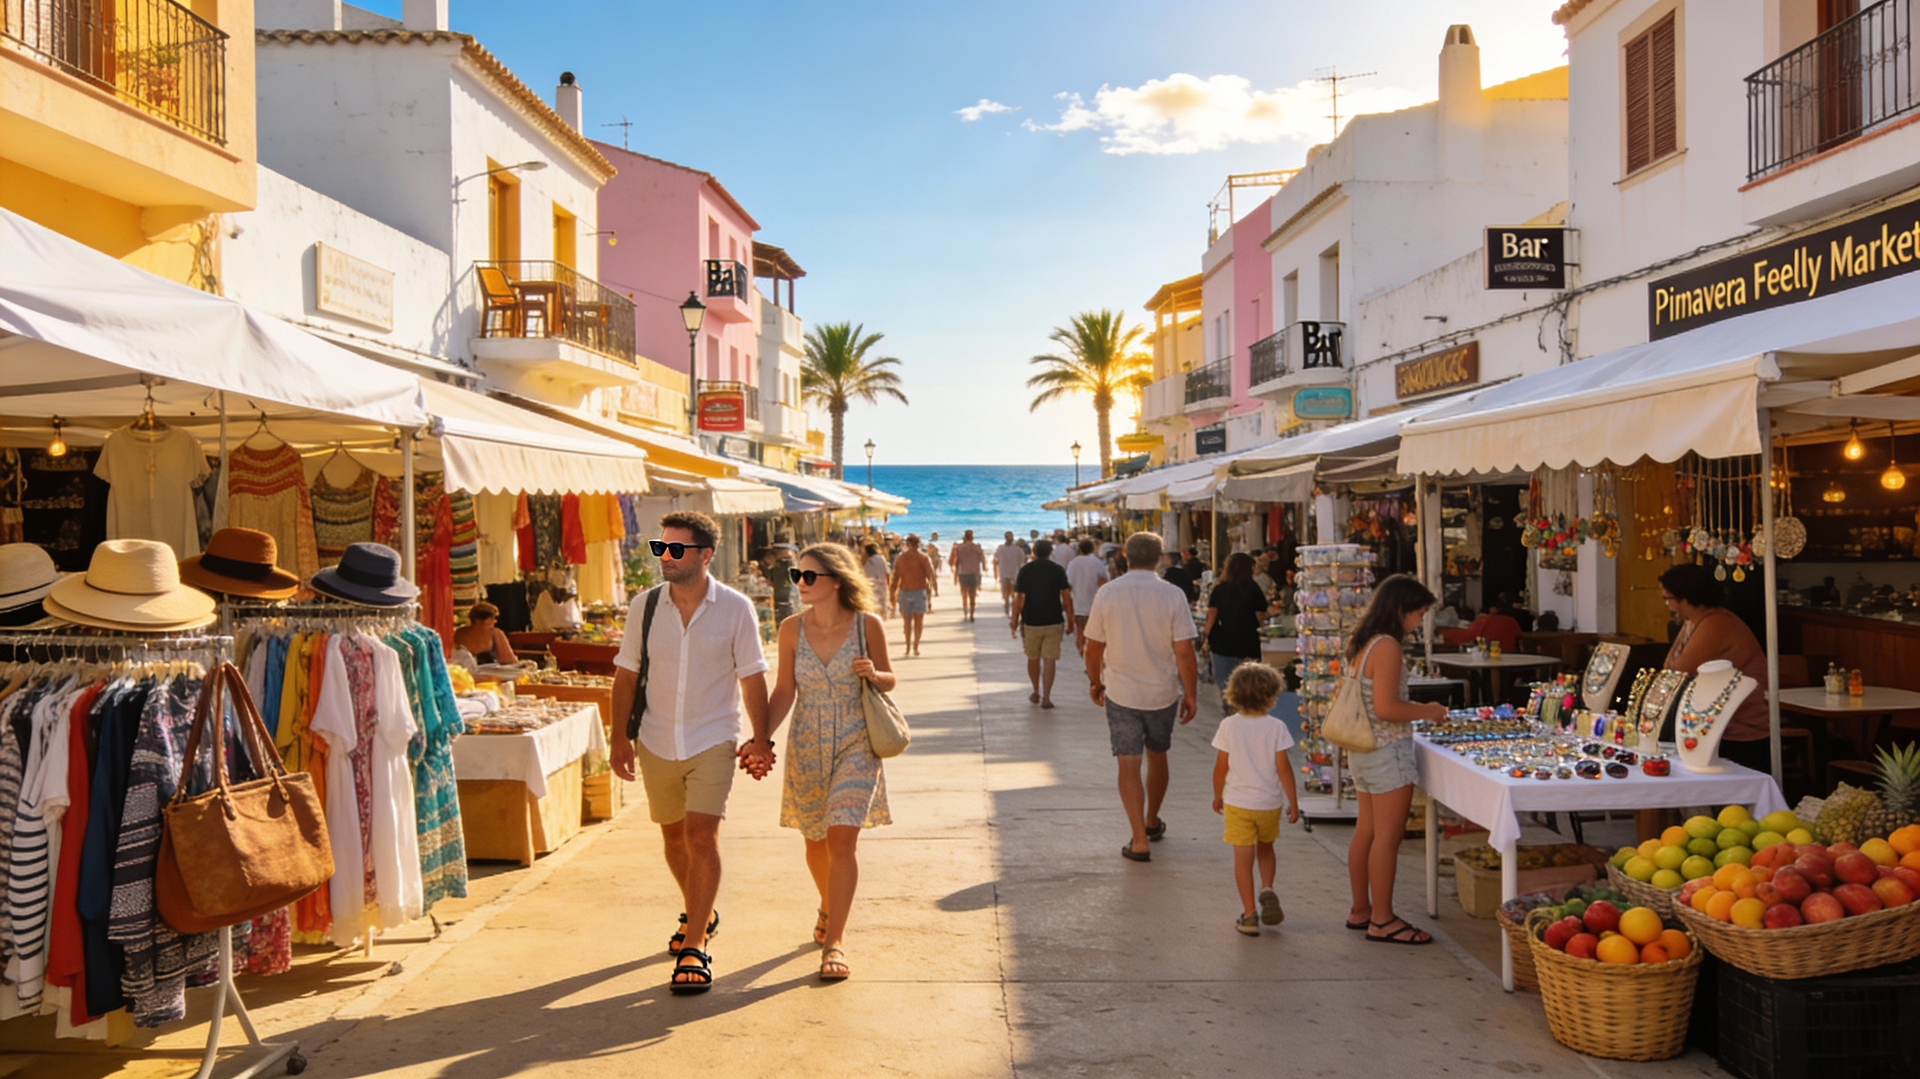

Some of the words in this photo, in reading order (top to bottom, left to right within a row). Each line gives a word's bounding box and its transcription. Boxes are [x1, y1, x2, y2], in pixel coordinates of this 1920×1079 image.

[1502, 232, 1549, 259] Bar
[1655, 276, 1747, 326] Pimavera
[1753, 246, 1823, 300] Feelly
[1829, 219, 1920, 282] Market
